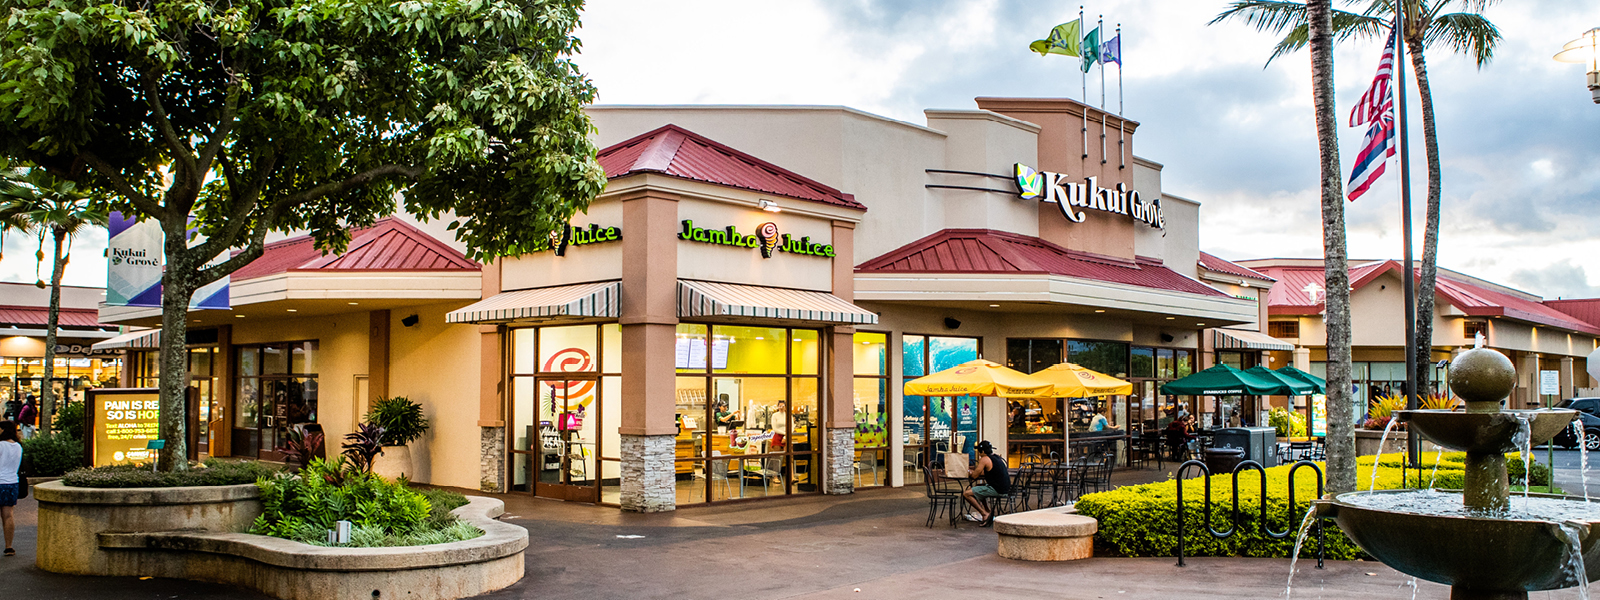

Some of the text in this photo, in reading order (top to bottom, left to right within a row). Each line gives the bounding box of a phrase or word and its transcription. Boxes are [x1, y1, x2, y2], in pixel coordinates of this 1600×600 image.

[1041, 170, 1128, 223] Kukui
[567, 222, 619, 246] Juice
[680, 219, 837, 257] Jamba Juice
[112, 247, 147, 259] Kukui
[104, 400, 160, 411] PAIN IS RE
[106, 410, 124, 420] SO
[125, 410, 137, 420] IS
